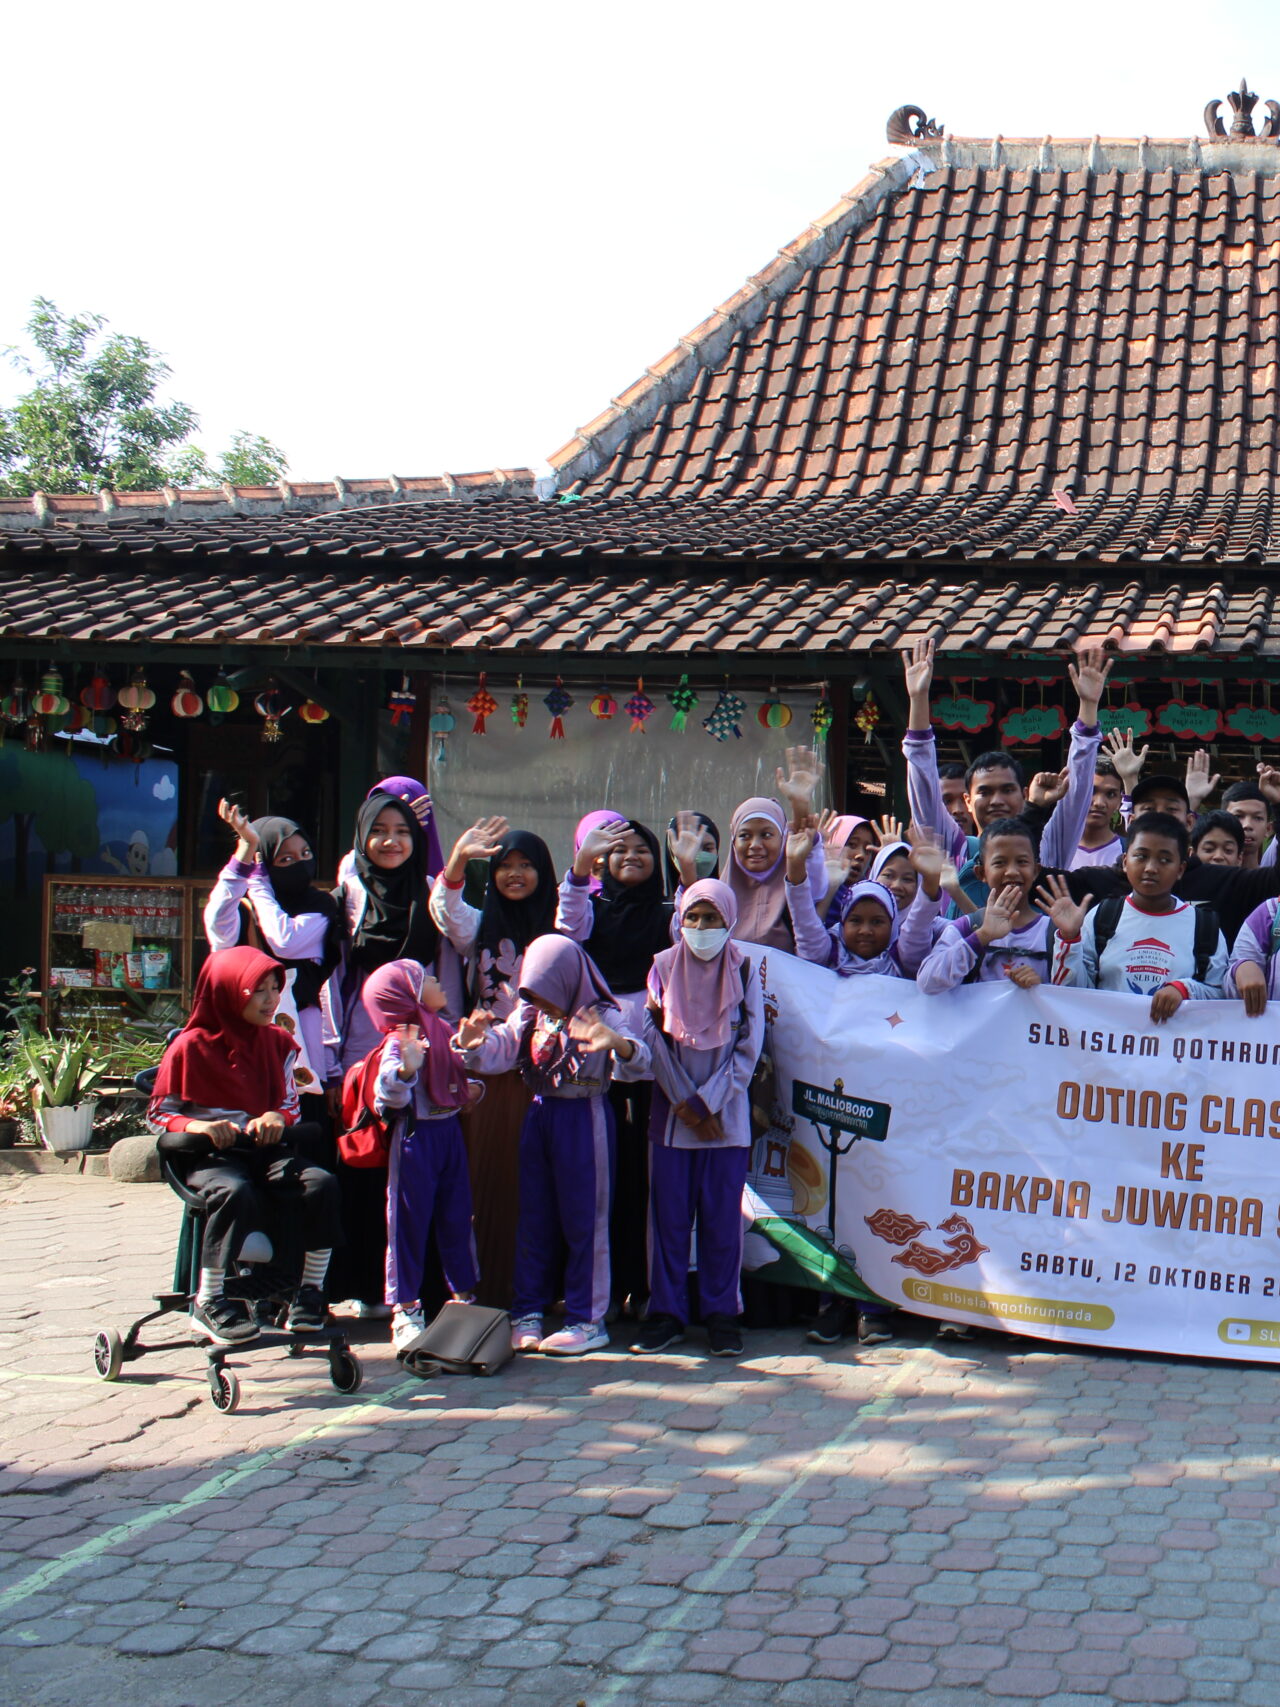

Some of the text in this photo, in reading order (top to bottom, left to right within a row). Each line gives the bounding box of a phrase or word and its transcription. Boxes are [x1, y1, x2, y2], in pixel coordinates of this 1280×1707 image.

[1133, 973, 1162, 984] SLB IQ
[1029, 1022, 1070, 1047] SLB
[1081, 1030, 1160, 1057] ISLAM
[803, 1089, 817, 1103] JL.
[817, 1093, 874, 1119] MALIOBORO
[1056, 1080, 1187, 1131] OUTING
[1160, 1141, 1206, 1181] KE
[949, 1168, 1091, 1221] BAKPIA
[1101, 1185, 1263, 1237] JUWARA
[1020, 1251, 1103, 1284] SABTU,
[1113, 1261, 1137, 1283] 12
[1148, 1265, 1251, 1295] OKTOBER
[942, 1290, 1093, 1323] slbislamqothrunnada
